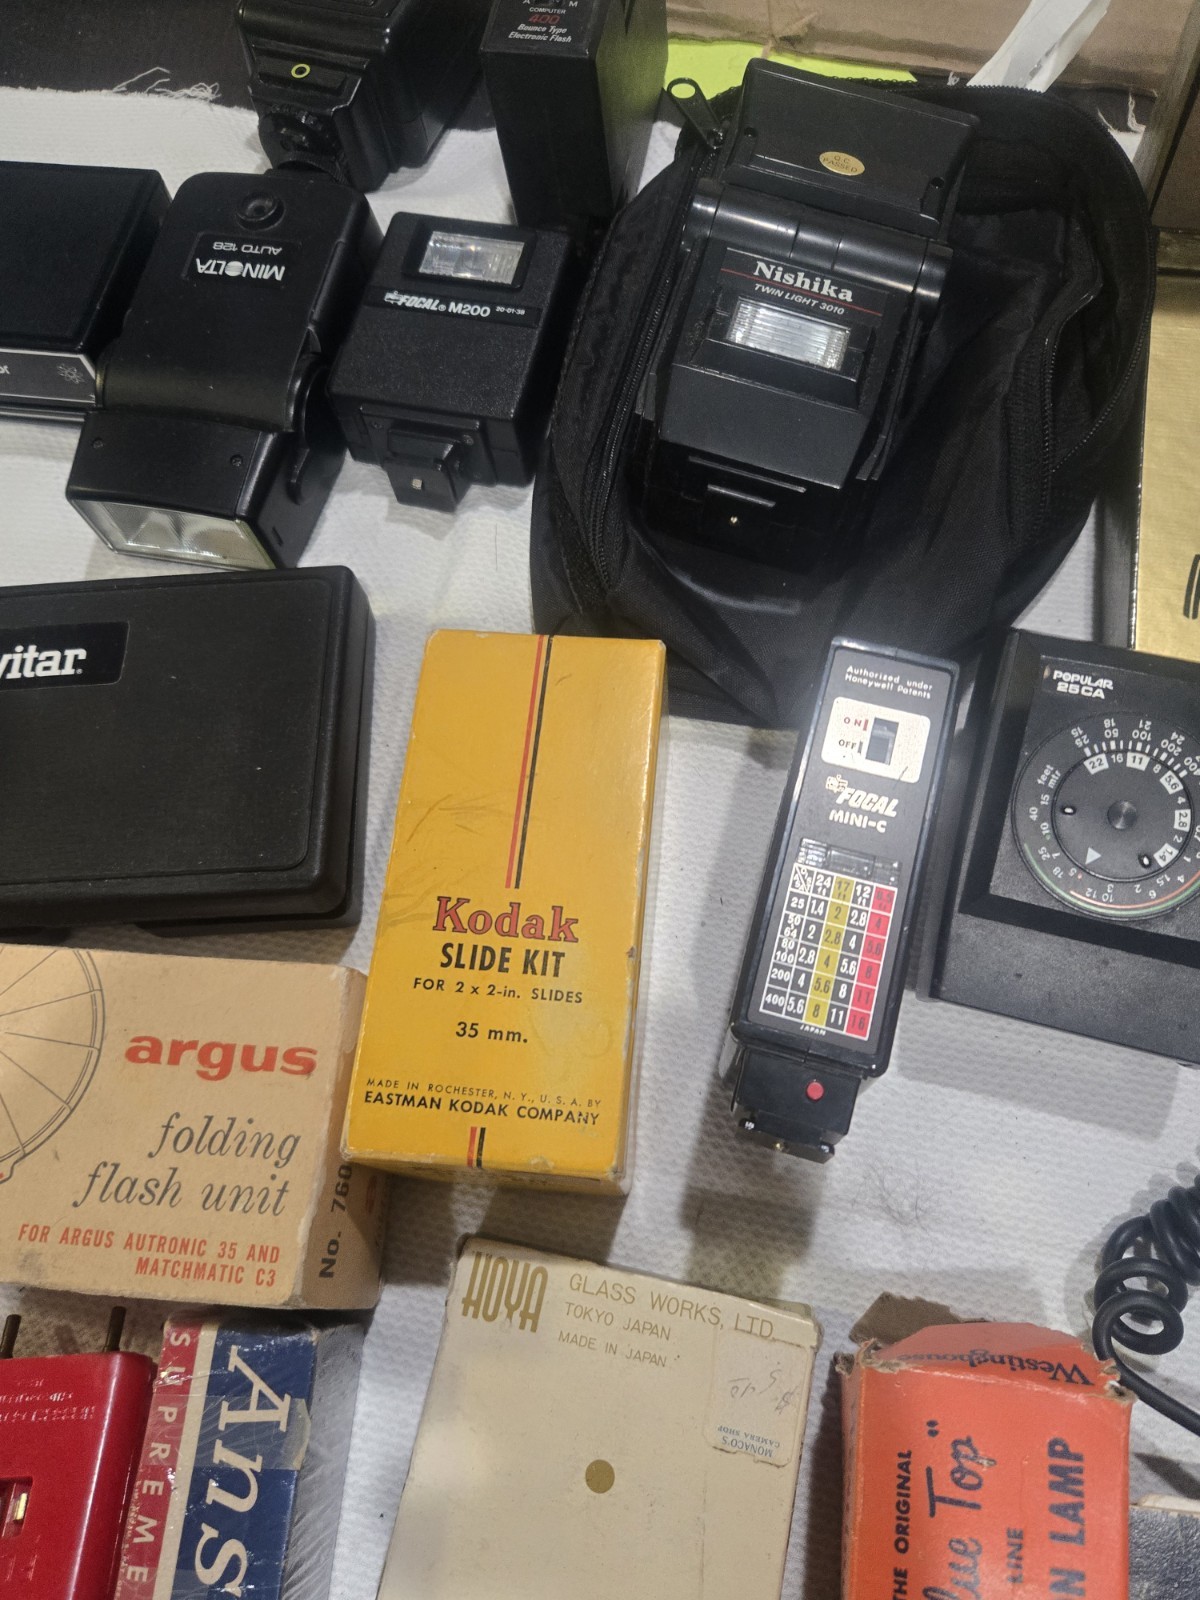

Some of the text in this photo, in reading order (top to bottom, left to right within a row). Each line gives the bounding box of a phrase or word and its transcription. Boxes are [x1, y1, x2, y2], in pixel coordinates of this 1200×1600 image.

[517, 24, 568, 34] Bounce Type
[528, 14, 560, 24] 400
[508, 32, 572, 42] Electronic Flash
[240, 244, 282, 255] AUTO
[196, 258, 286, 280] MINOLTA
[754, 260, 852, 302] Nishika
[448, 302, 490, 318] M200
[754, 284, 845, 315] TWIN LIGHT 3010
[844, 674, 931, 700] Honeywell Patents
[846, 665, 933, 691] Authorized under
[1052, 670, 1114, 690] POPULAR
[844, 716, 862, 727] ON
[1070, 718, 1185, 746] 15 18 21 24
[838, 739, 856, 750] OFF
[1074, 728, 1182, 756] 25 50 100 200
[1048, 770, 1061, 788] mtr
[836, 788, 898, 818] FOCAL
[1040, 794, 1050, 806] 15
[1089, 753, 1188, 862] 22 16 11 8 5.6 4 2.8 2 1.4
[829, 810, 887, 833] MINI-C
[1029, 764, 1185, 903] feet 40 25 18 12 10 6 4
[1040, 822, 1050, 836] 10
[816, 874, 832, 888] 24
[856, 884, 871, 899] 12
[1068, 868, 1077, 876] 5
[1156, 874, 1170, 886] 1.5
[1107, 884, 1114, 893] 3
[1134, 884, 1142, 894] 2
[432, 896, 579, 943] Kodak
[790, 896, 805, 910] 25
[810, 899, 824, 916] 1.4
[834, 906, 842, 920] 2
[850, 910, 867, 927] 2.8
[784, 926, 798, 939] 64
[788, 914, 801, 926] 50
[807, 924, 816, 940] 2
[824, 929, 842, 945] 2.8
[849, 934, 856, 950] 4
[440, 942, 566, 978] SLIDE KIT
[776, 950, 794, 964] 100
[781, 938, 794, 950] 80
[798, 947, 816, 964] 2.8
[824, 954, 830, 968] 4
[840, 958, 857, 976] 5.6
[413, 978, 583, 1004] FOR 2 x 2-in. SLIDES
[770, 968, 871, 1005] 200 4 5.6 8 11
[766, 993, 865, 1031] 400 5.6 8 11 16
[456, 1022, 528, 1044] 35 mm.
[800, 1024, 826, 1036] JAPAN
[125, 1035, 318, 1082] argus
[366, 1078, 400, 1090] MADE
[407, 1082, 420, 1090] IN
[428, 1084, 498, 1100] ROCHESTER,
[588, 1099, 602, 1108] BY
[364, 1091, 600, 1125] EASTMAN KODAK COMPANY
[148, 1112, 301, 1168] folding
[72, 1160, 290, 1216] flash unit
[319, 1164, 353, 1278] No. 760
[18, 1224, 280, 1264] FOR ARGUS AUTRONIC 35 AND
[135, 1256, 276, 1288] MATCHMATIC C3
[462, 1252, 548, 1332] HOYA
[565, 1302, 671, 1341] TOKYO JAPAN
[570, 1273, 776, 1342] GLASS WORKS, LTD.
[558, 1330, 667, 1368] MADE IN JAPAN
[898, 1348, 1094, 1386] Westinghouse
[718, 1425, 780, 1449] CAMERA SHOP
[722, 1435, 774, 1458] MONACO'S
[126, 1332, 190, 1583] SUPREME
[894, 1450, 912, 1554] ORIGINAL
[1048, 1438, 1086, 1546] LAMP
[1006, 1527, 1024, 1584] LINE
